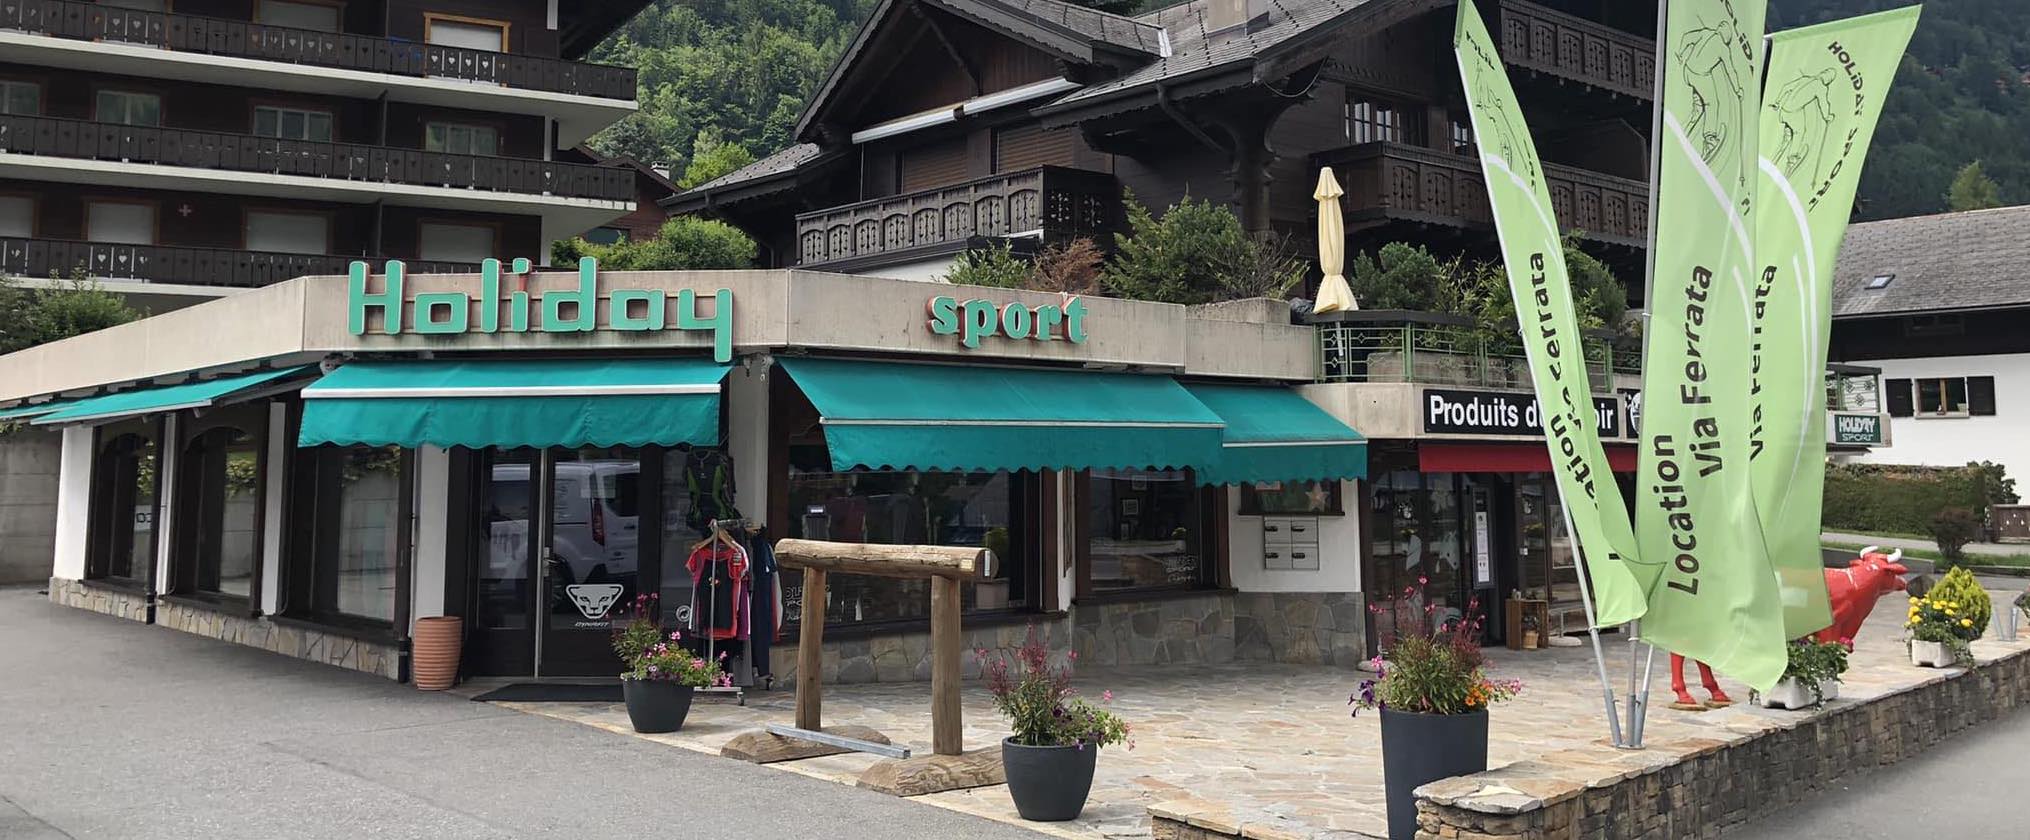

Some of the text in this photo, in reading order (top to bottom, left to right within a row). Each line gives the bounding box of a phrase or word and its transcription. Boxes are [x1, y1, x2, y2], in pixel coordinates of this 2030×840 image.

[348, 256, 733, 363] Holiday
[927, 296, 1089, 348] sport
[1681, 265, 1723, 478] Via Ferrata
[1429, 395, 1519, 428] Produits
[1750, 403, 1764, 462] Via
[1838, 416, 1876, 433] HOLIDAY
[1842, 433, 1874, 442] SPORT
[1550, 413, 1600, 511] ation
[1653, 434, 1700, 596] Location
